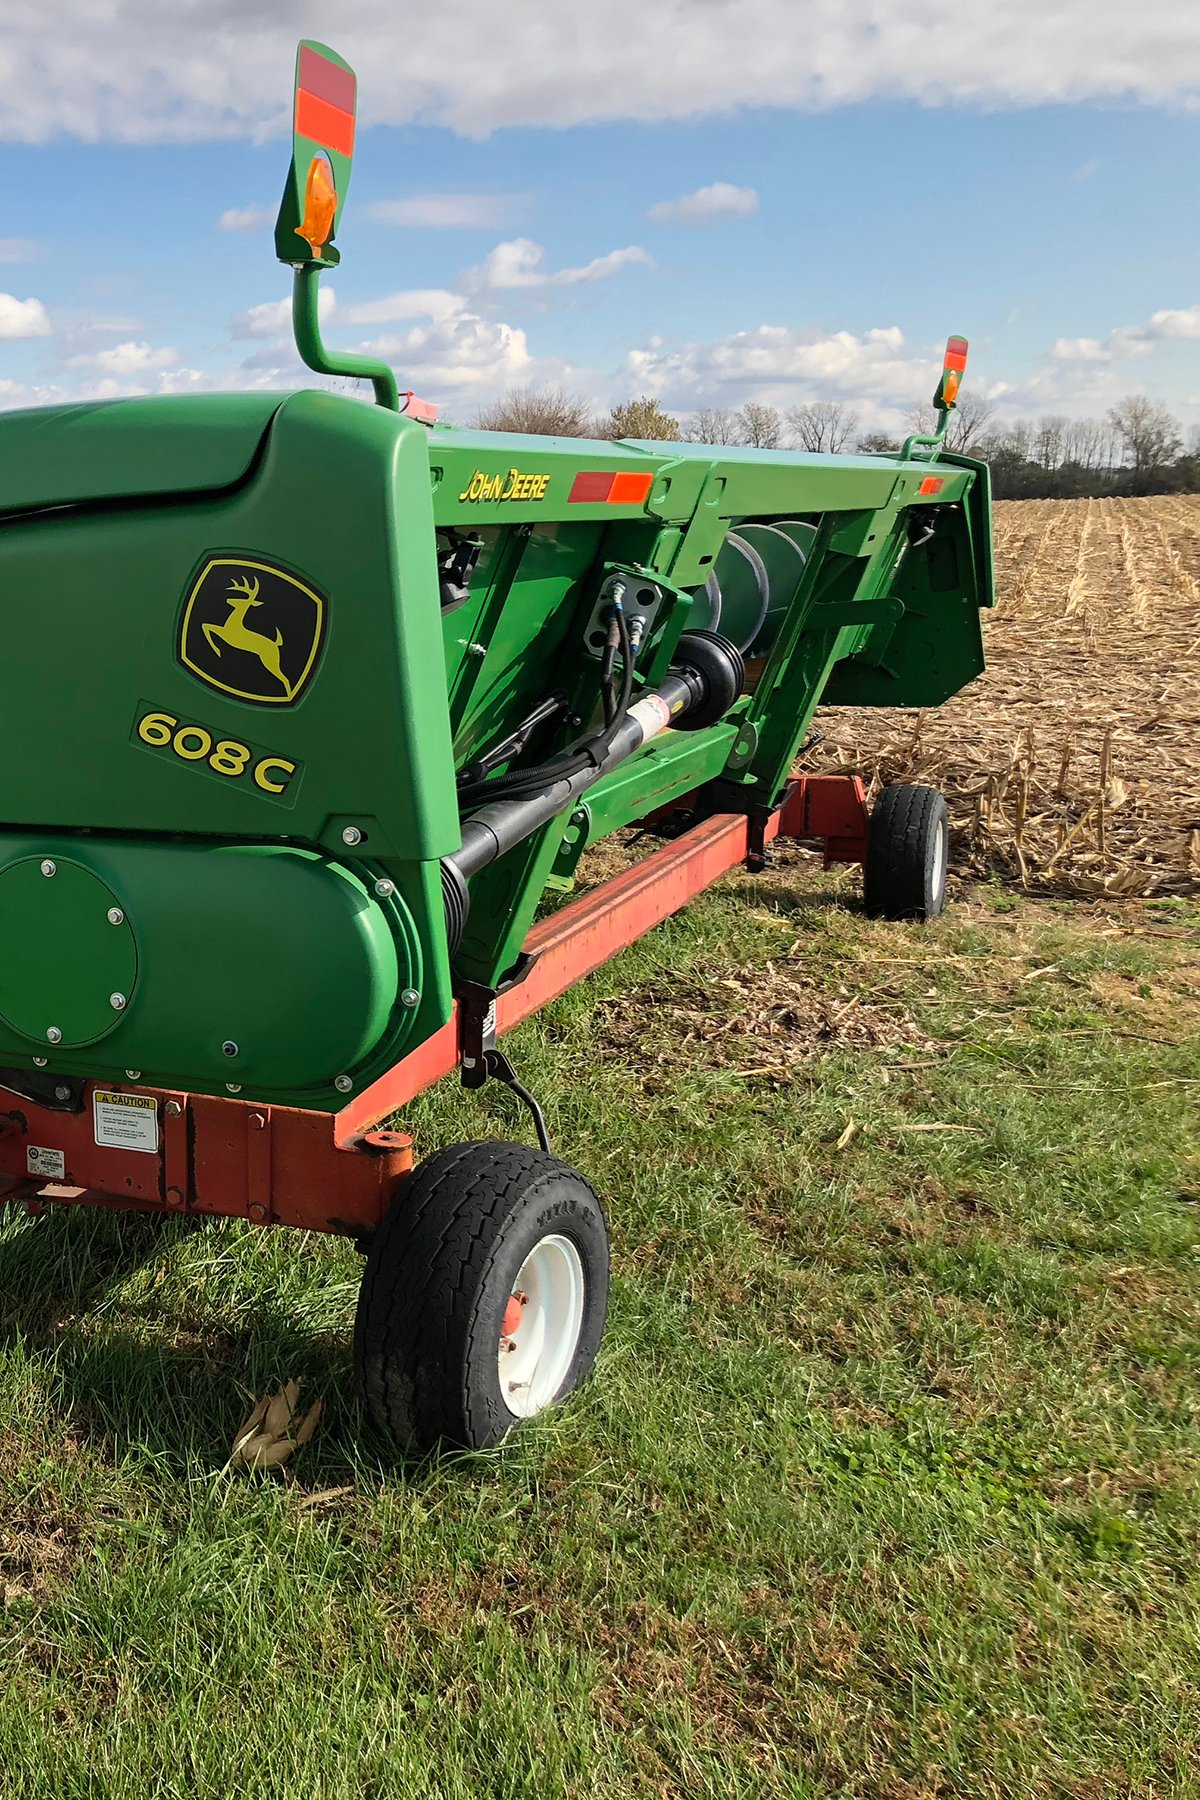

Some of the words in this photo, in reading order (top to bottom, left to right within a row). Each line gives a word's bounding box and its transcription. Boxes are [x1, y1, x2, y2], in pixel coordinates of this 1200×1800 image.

[459, 468, 503, 503] JOHN
[502, 468, 551, 502] DEERE
[138, 711, 296, 794] 608C
[111, 1095, 150, 1108] CAUTION
